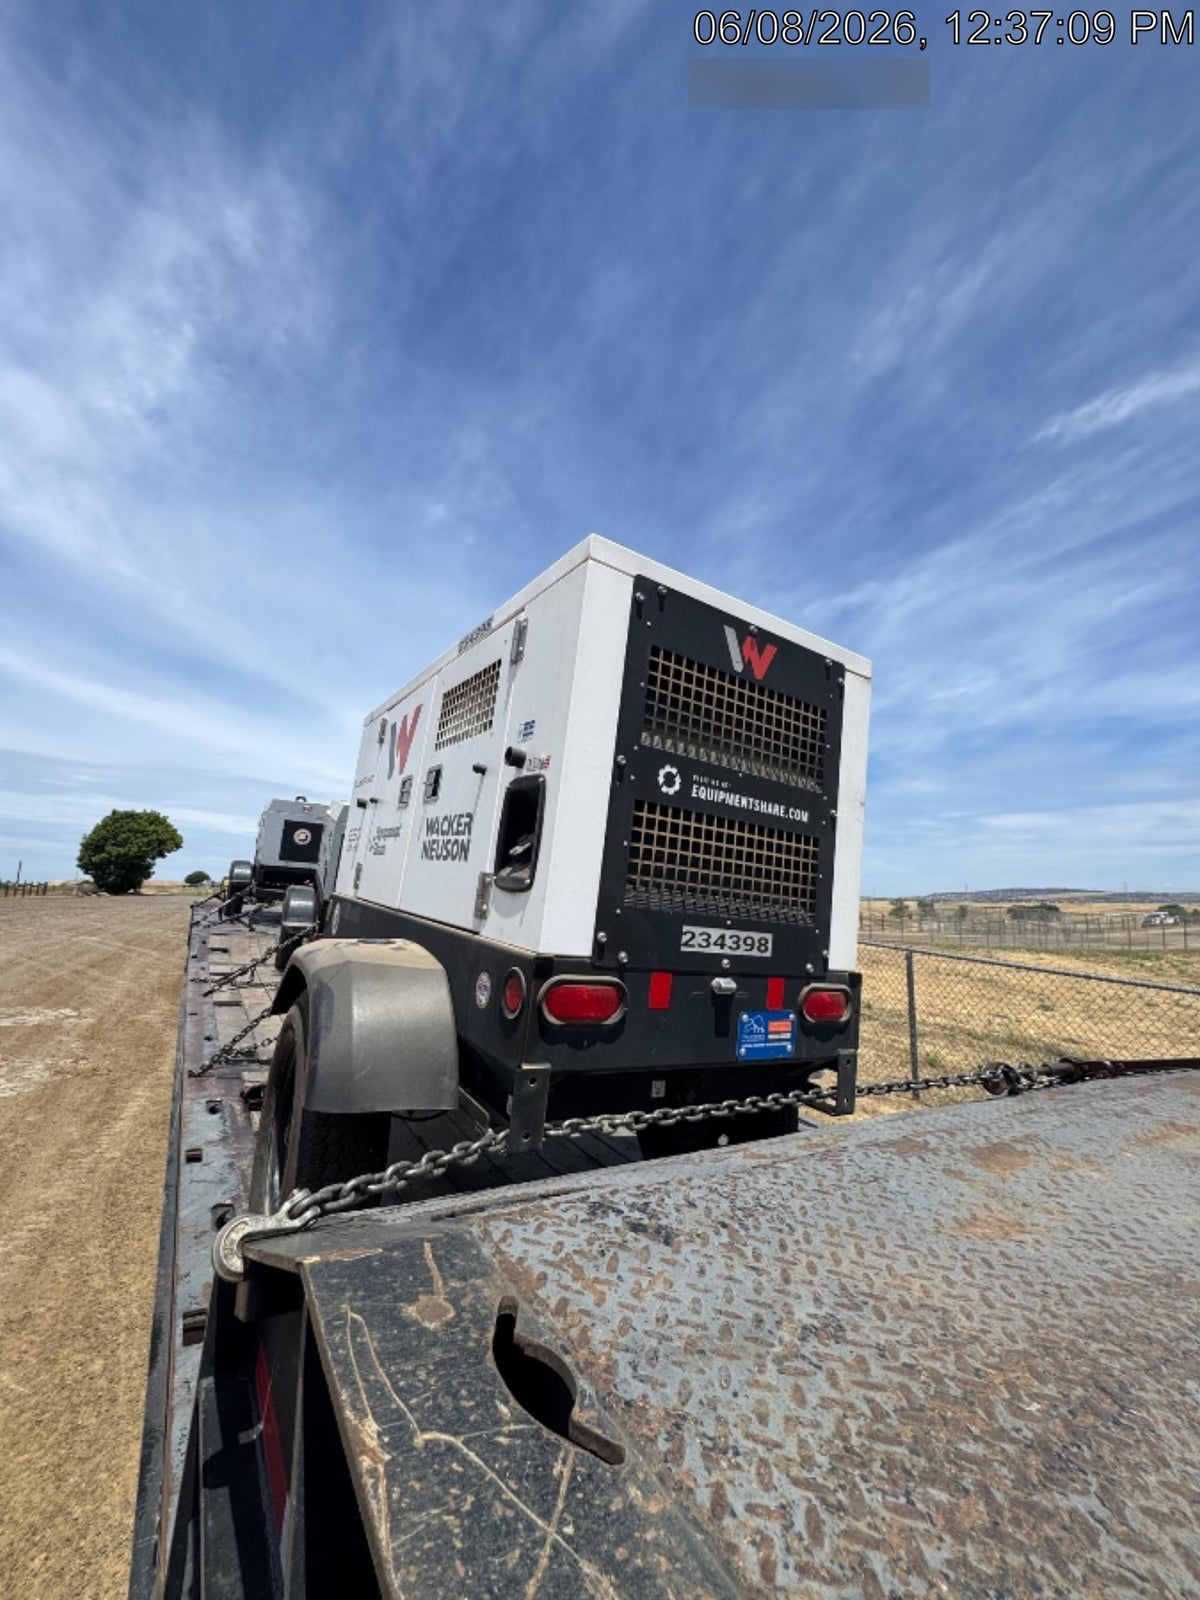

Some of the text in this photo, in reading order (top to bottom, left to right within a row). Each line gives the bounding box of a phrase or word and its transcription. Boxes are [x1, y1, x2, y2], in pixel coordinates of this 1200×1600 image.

[691, 783, 809, 823] EQUIPMENTSHARE.COM
[426, 811, 474, 837] WACKER
[421, 838, 472, 863] NEUSON
[680, 930, 769, 954] 234398
